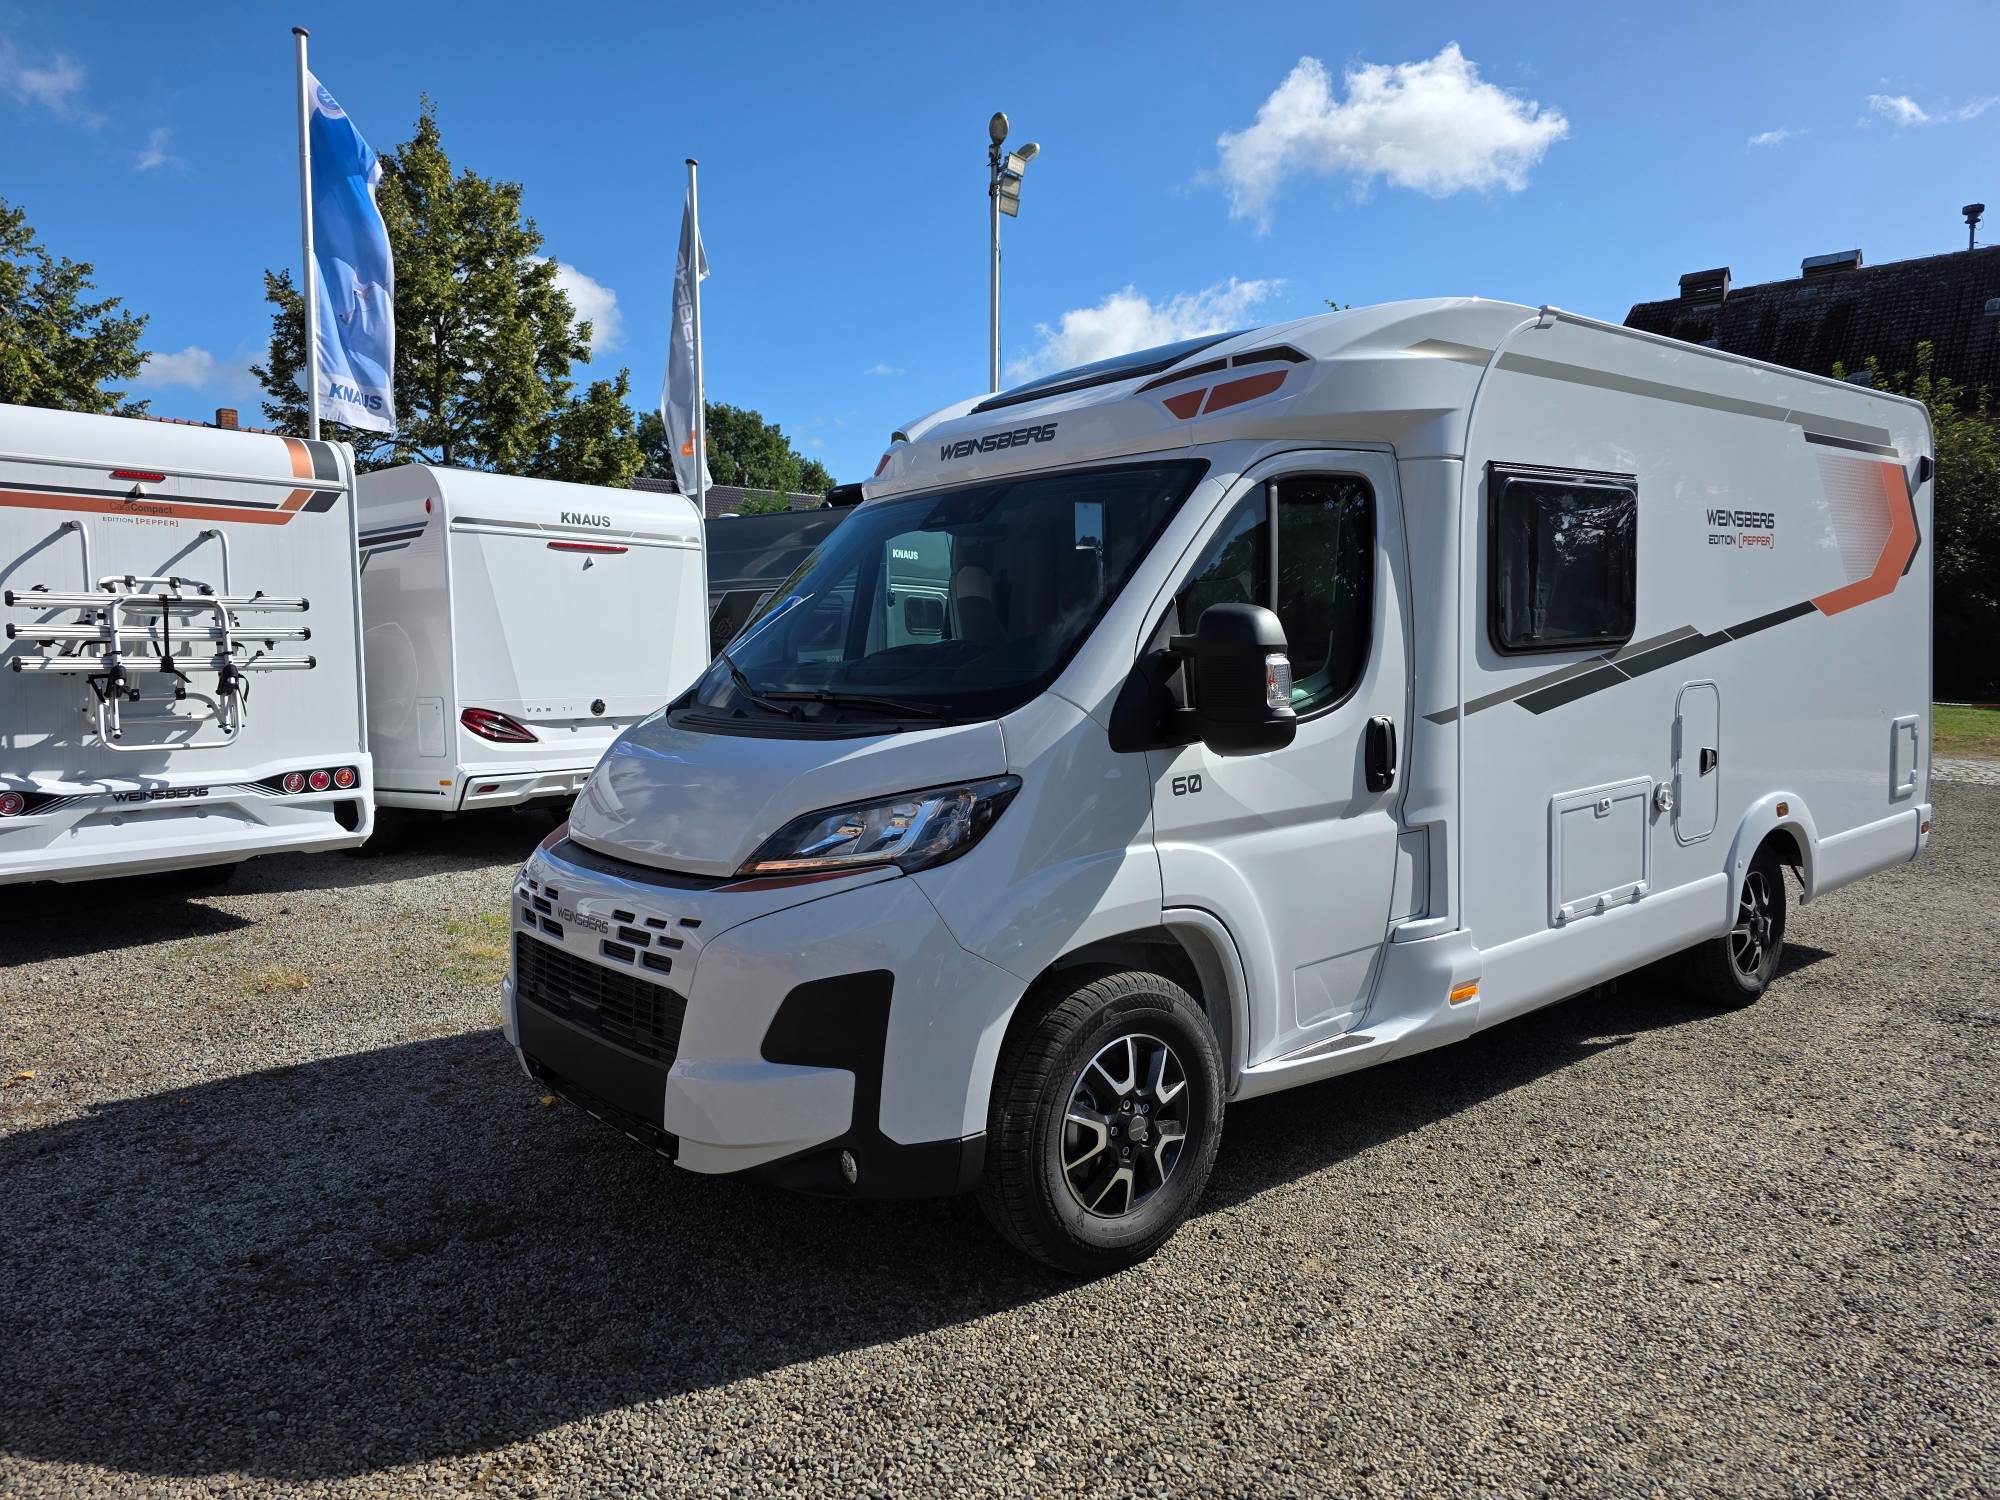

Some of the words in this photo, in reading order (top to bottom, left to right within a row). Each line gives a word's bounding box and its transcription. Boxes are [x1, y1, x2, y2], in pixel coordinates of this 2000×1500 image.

[329, 383, 383, 410] KNAUS
[940, 422, 1059, 462] WEINSBERG
[109, 502, 173, 514] CaraCompact
[102, 516, 134, 524] EDITION
[560, 511, 611, 528] KNAUS
[1706, 508, 1775, 529] WEINSBERG
[1708, 534, 1737, 545] EDITION
[1738, 532, 1775, 550] [PEPPER]
[892, 548, 919, 560] KNAUS
[1172, 774, 1203, 797] 60
[113, 787, 209, 803] WEINSBERG
[557, 906, 609, 935] WEINSBERG
